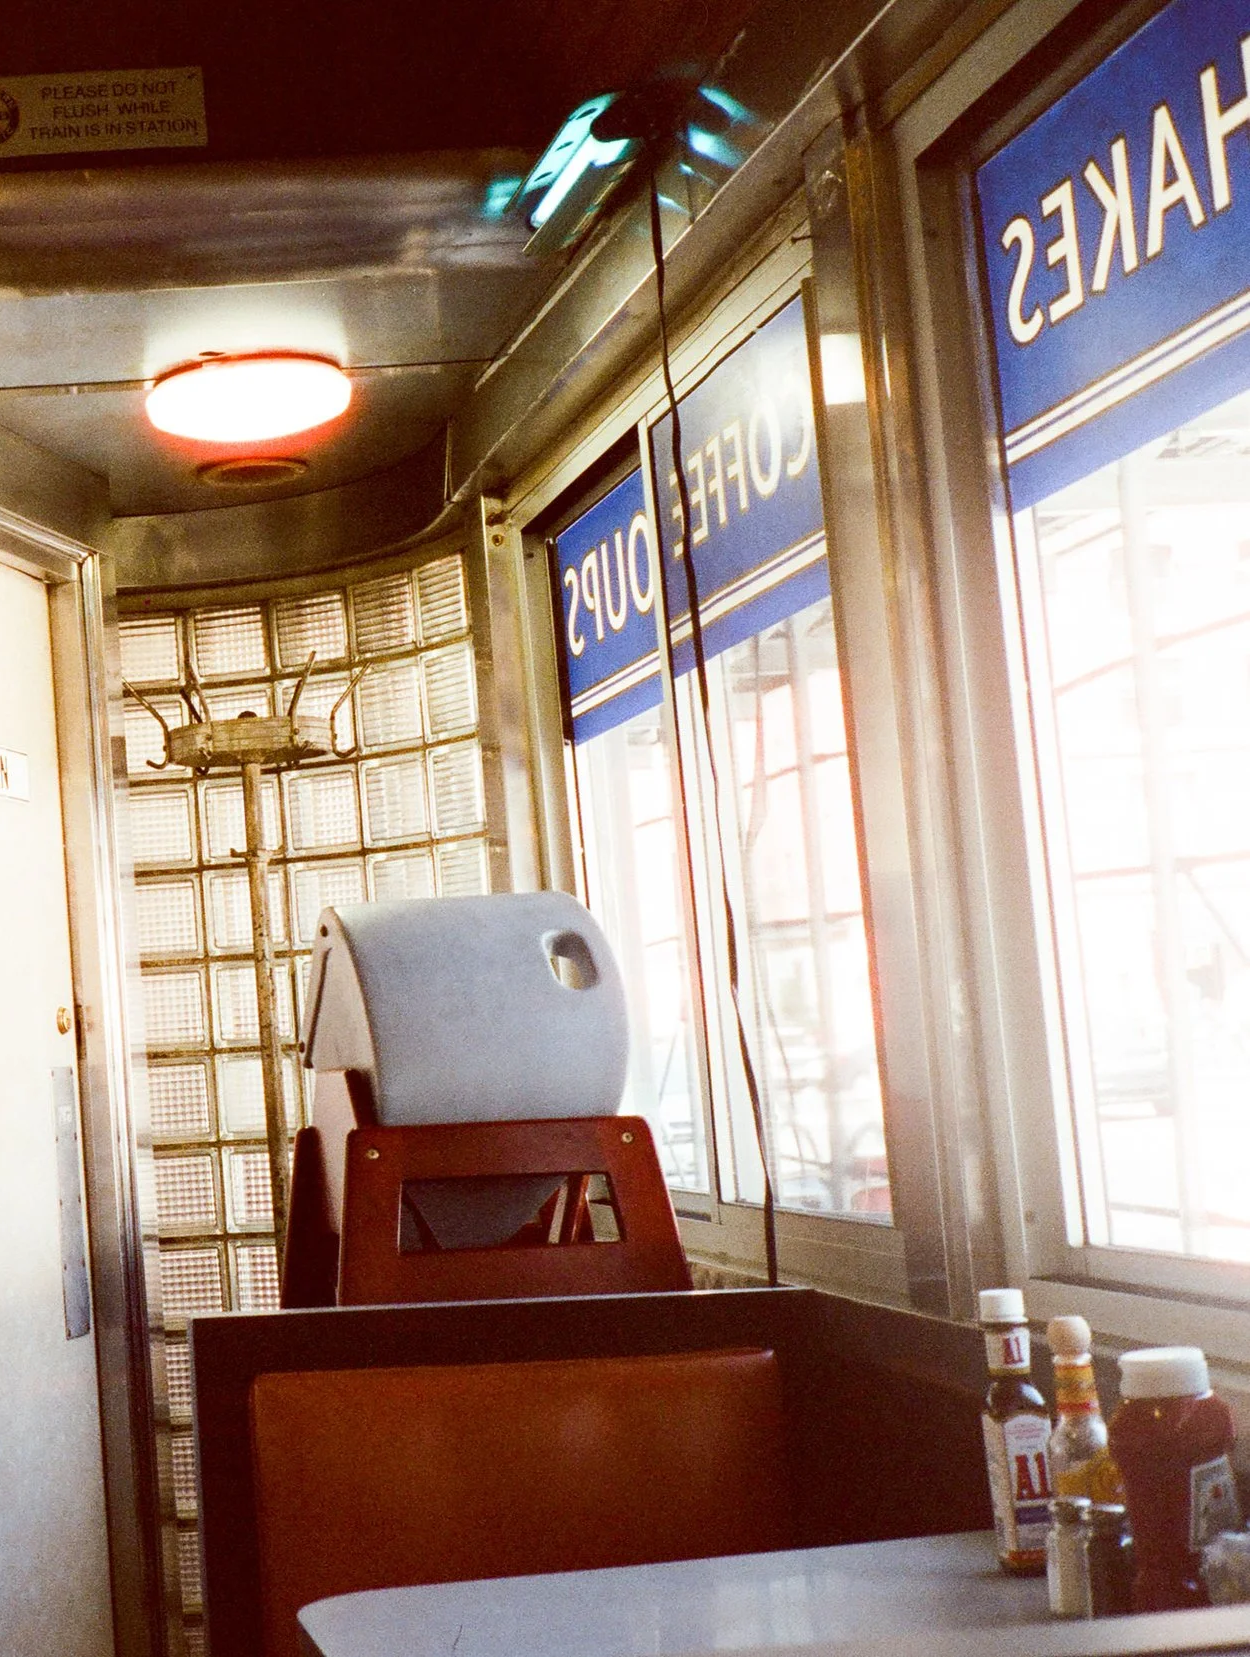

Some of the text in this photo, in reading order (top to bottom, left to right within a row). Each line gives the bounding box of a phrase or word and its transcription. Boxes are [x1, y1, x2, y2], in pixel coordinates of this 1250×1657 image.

[41, 80, 177, 100] PLEASE DO NOT
[53, 100, 170, 119] FLUSH WHILE
[29, 119, 198, 140] TRAIN IS IN STATION
